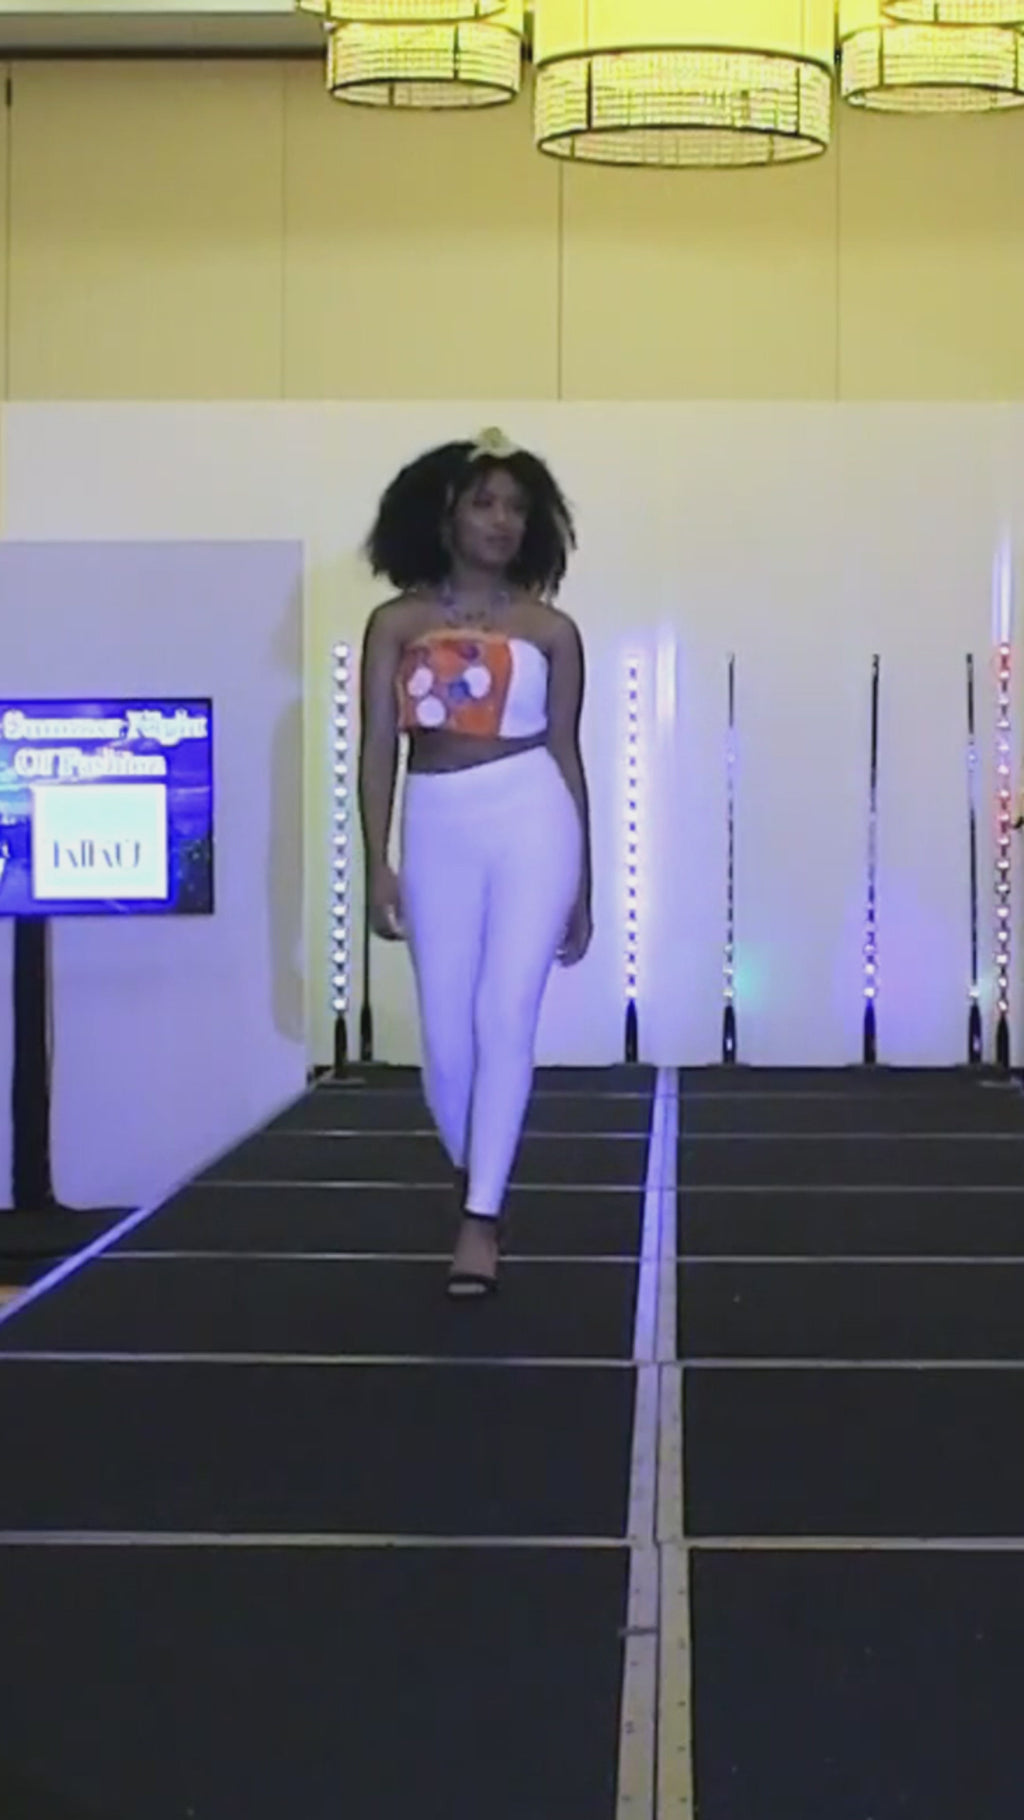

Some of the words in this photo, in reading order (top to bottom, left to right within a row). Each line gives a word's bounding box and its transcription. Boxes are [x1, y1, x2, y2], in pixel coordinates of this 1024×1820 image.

[3, 710, 126, 740] Summer
[126, 709, 207, 746] Night
[57, 747, 166, 776] Fashion
